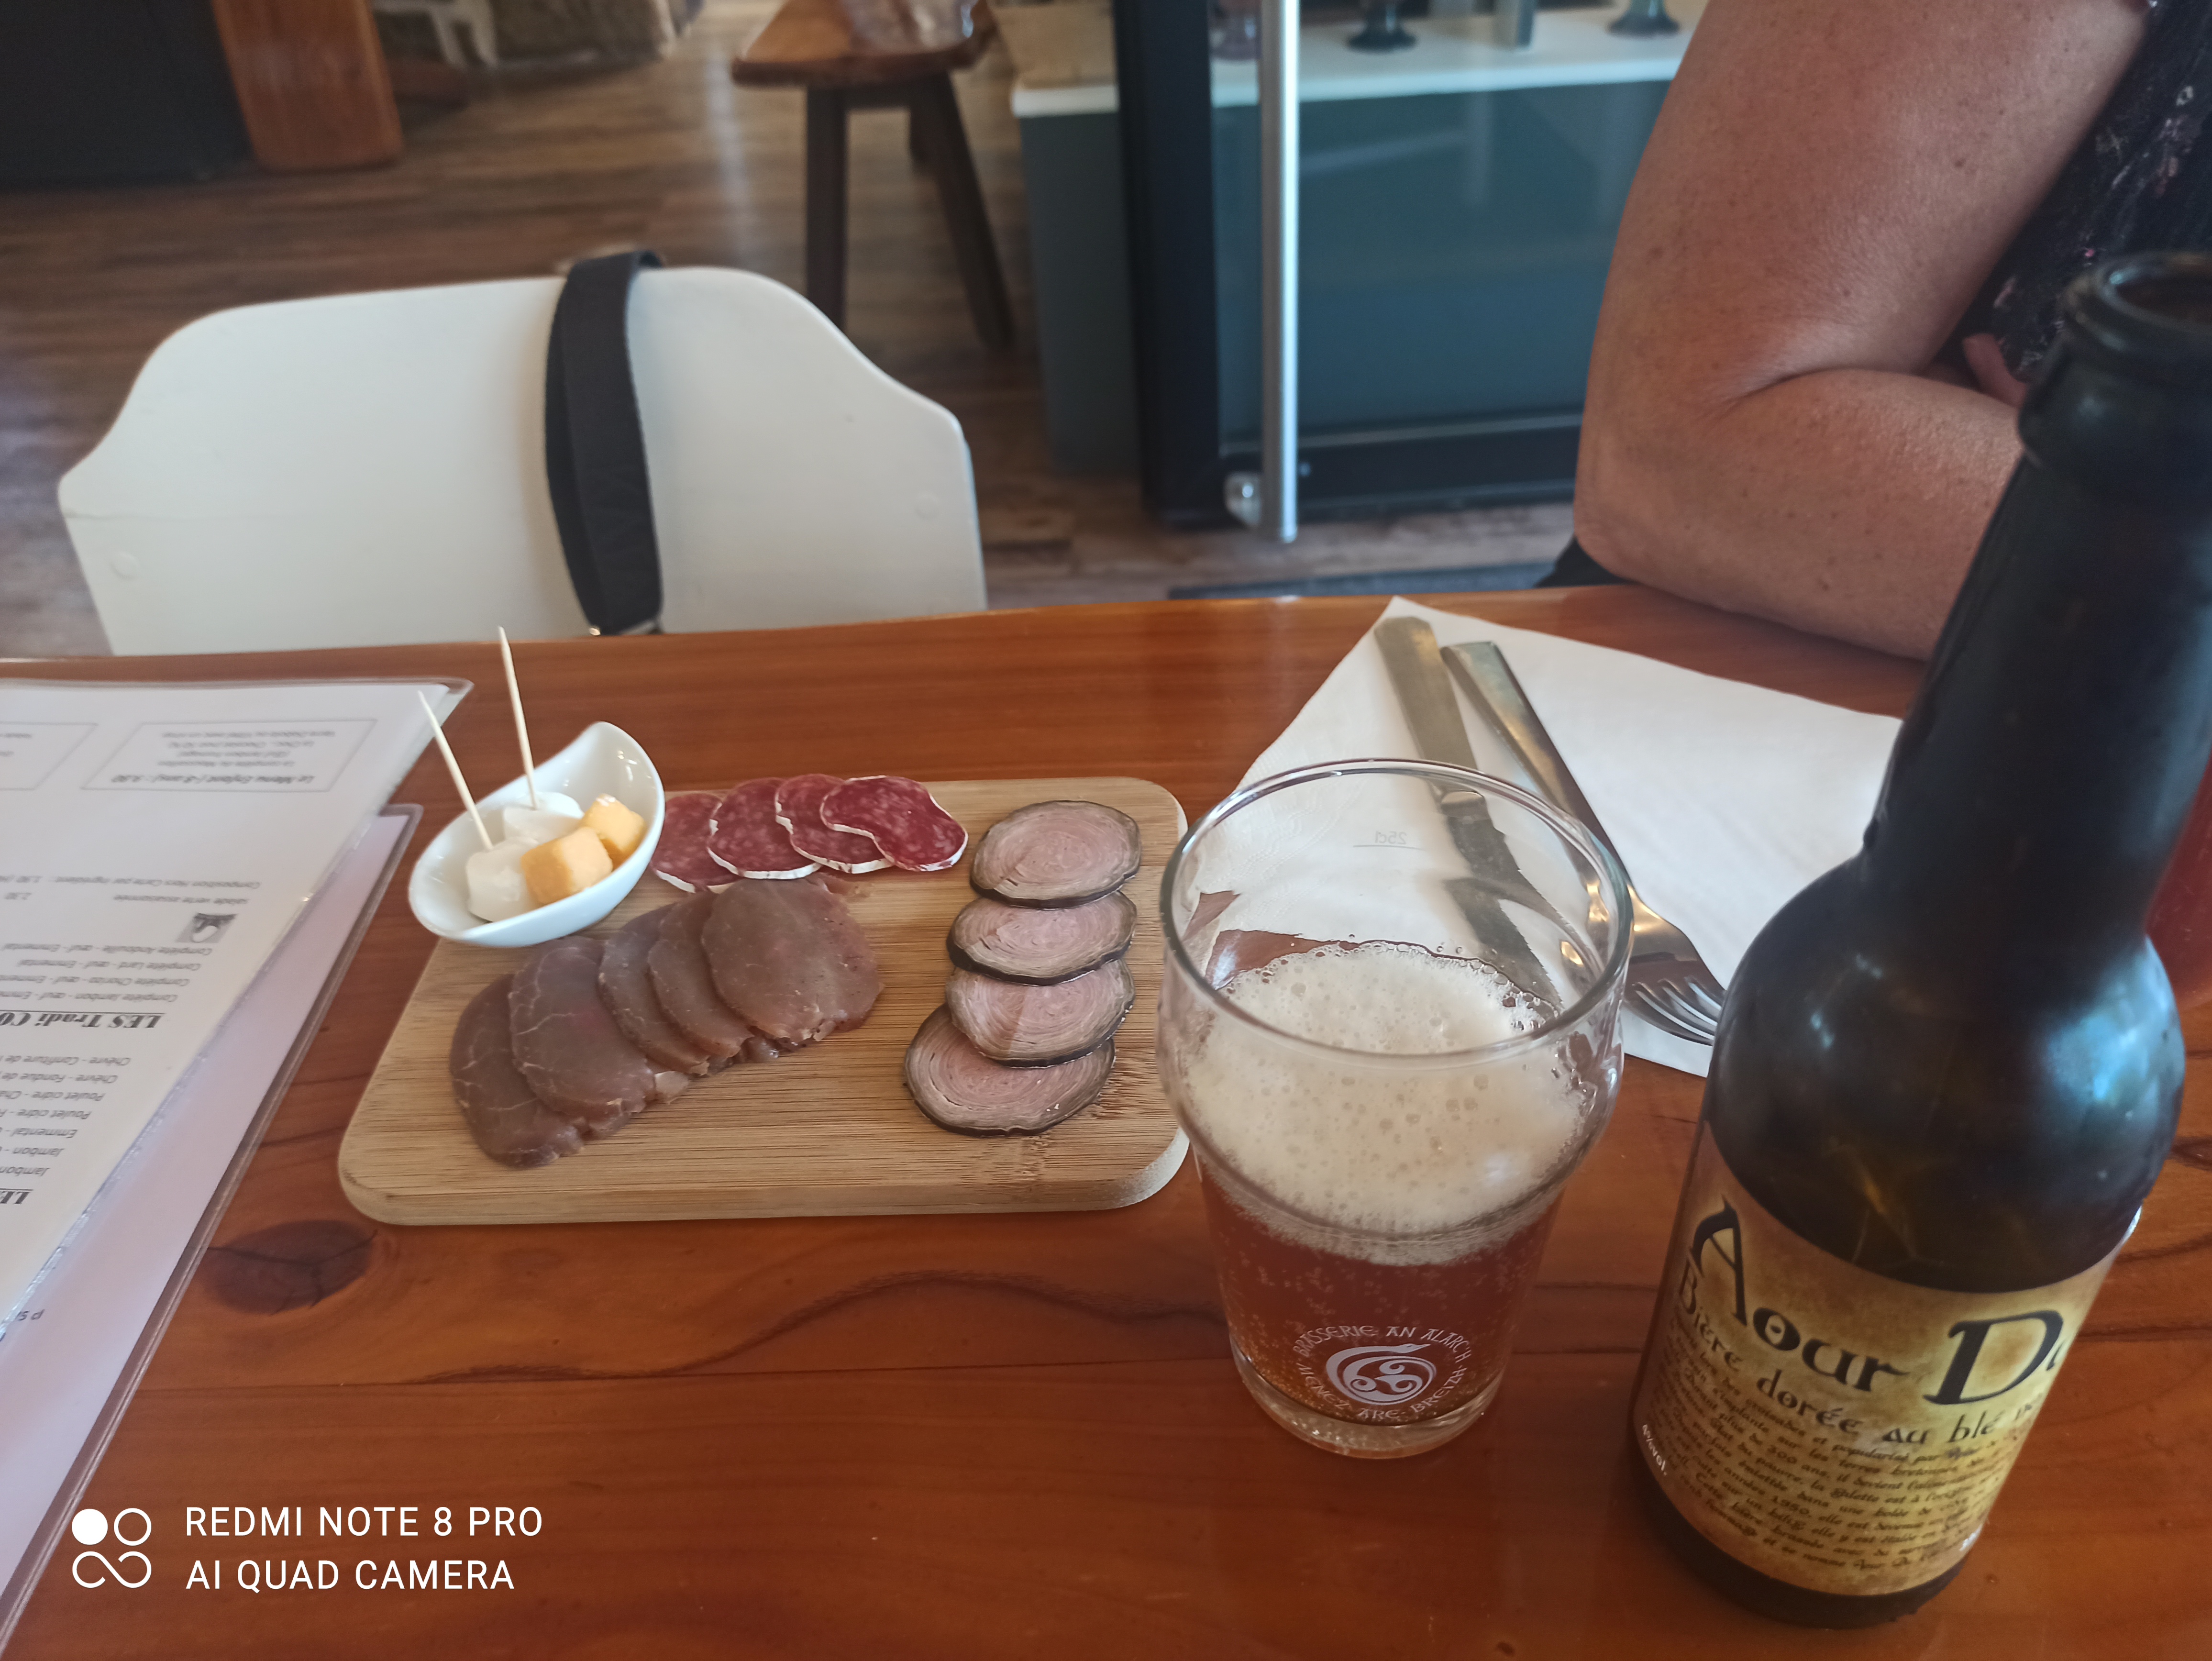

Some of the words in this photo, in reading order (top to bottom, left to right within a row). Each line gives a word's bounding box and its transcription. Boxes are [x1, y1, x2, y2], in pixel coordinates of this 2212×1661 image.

[34, 1013, 104, 1028] Tradi
[108, 1015, 163, 1029] LES
[1689, 1194, 1911, 1393] Aour
[1293, 1325, 1375, 1357] BRASSERIE
[1386, 1326, 1416, 1338] AN
[1420, 1328, 1472, 1363] ALARC'H
[1410, 1367, 1468, 1413] BREIZH
[1756, 1369, 1864, 1435] dorée
[1881, 1428, 1932, 1444] au
[1947, 1409, 2007, 1443] blé
[1767, 1444, 1798, 1464] 300
